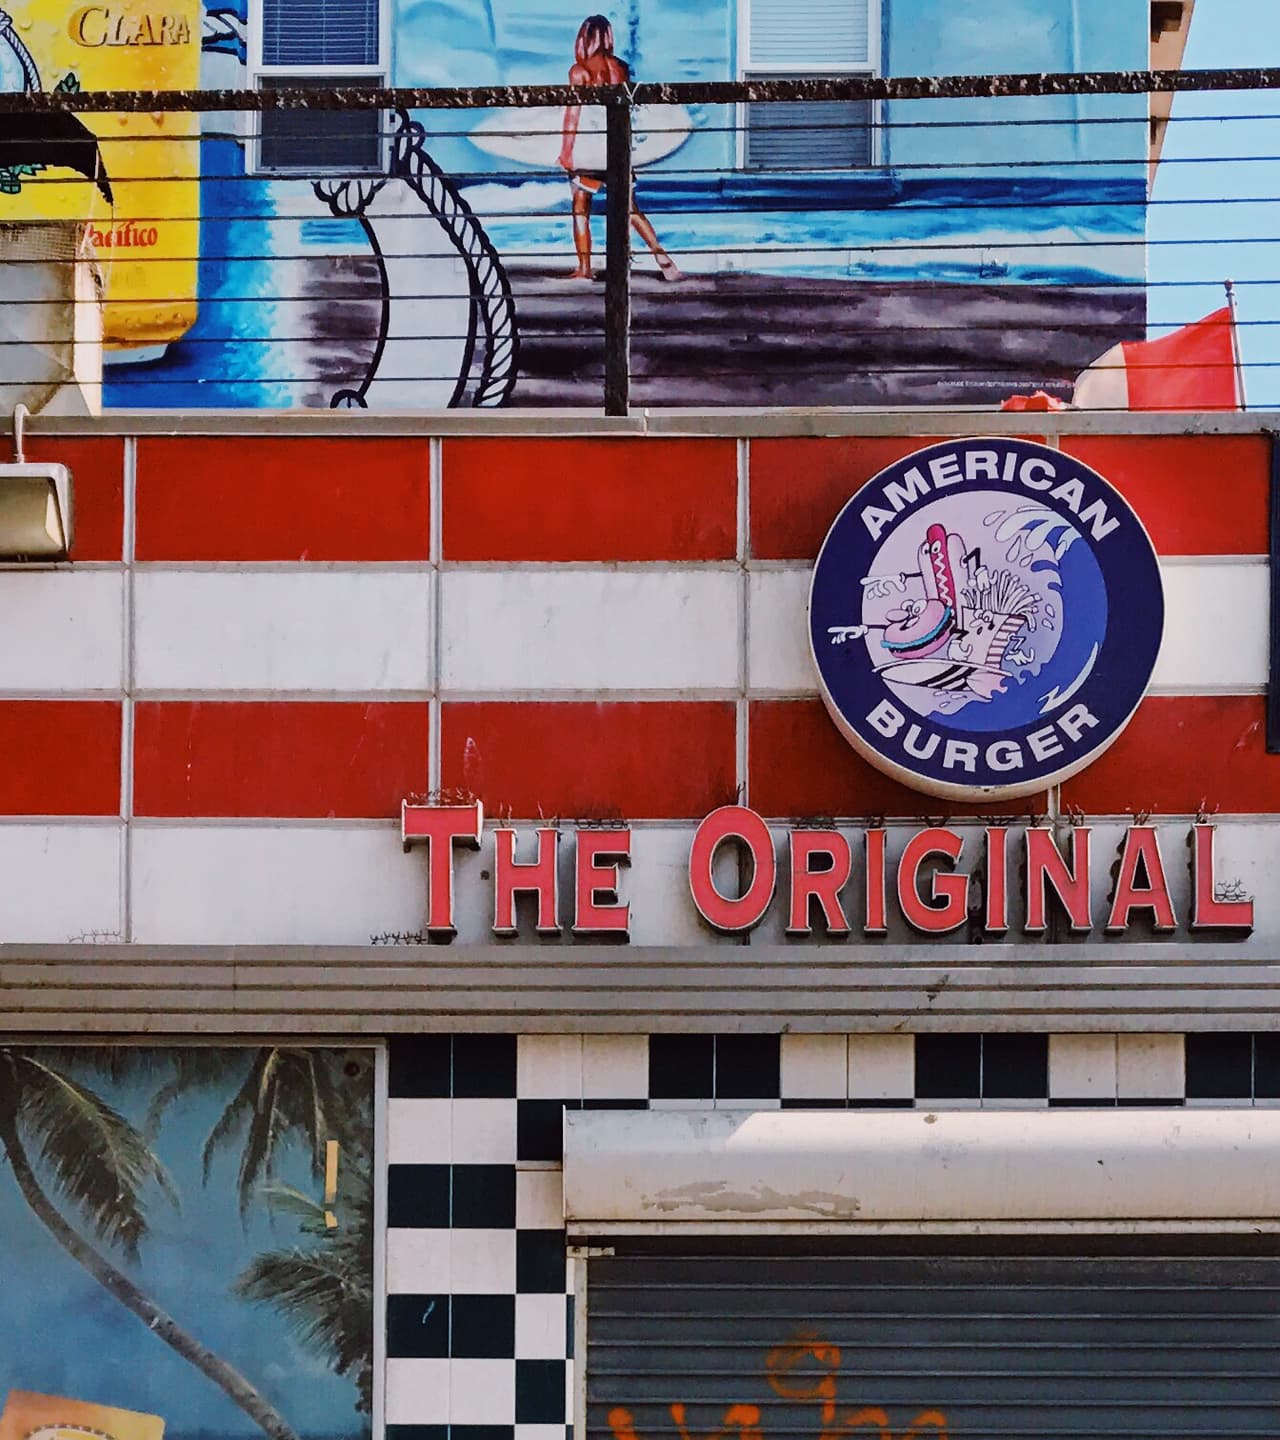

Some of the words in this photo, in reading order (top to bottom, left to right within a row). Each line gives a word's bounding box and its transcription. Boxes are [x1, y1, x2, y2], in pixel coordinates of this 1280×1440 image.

[67, 6, 191, 48] CLARA
[859, 449, 1121, 543] AMERICAN
[864, 698, 1101, 773] BURGER
[401, 799, 632, 938] THE
[688, 804, 1255, 940] ORIGINAL
